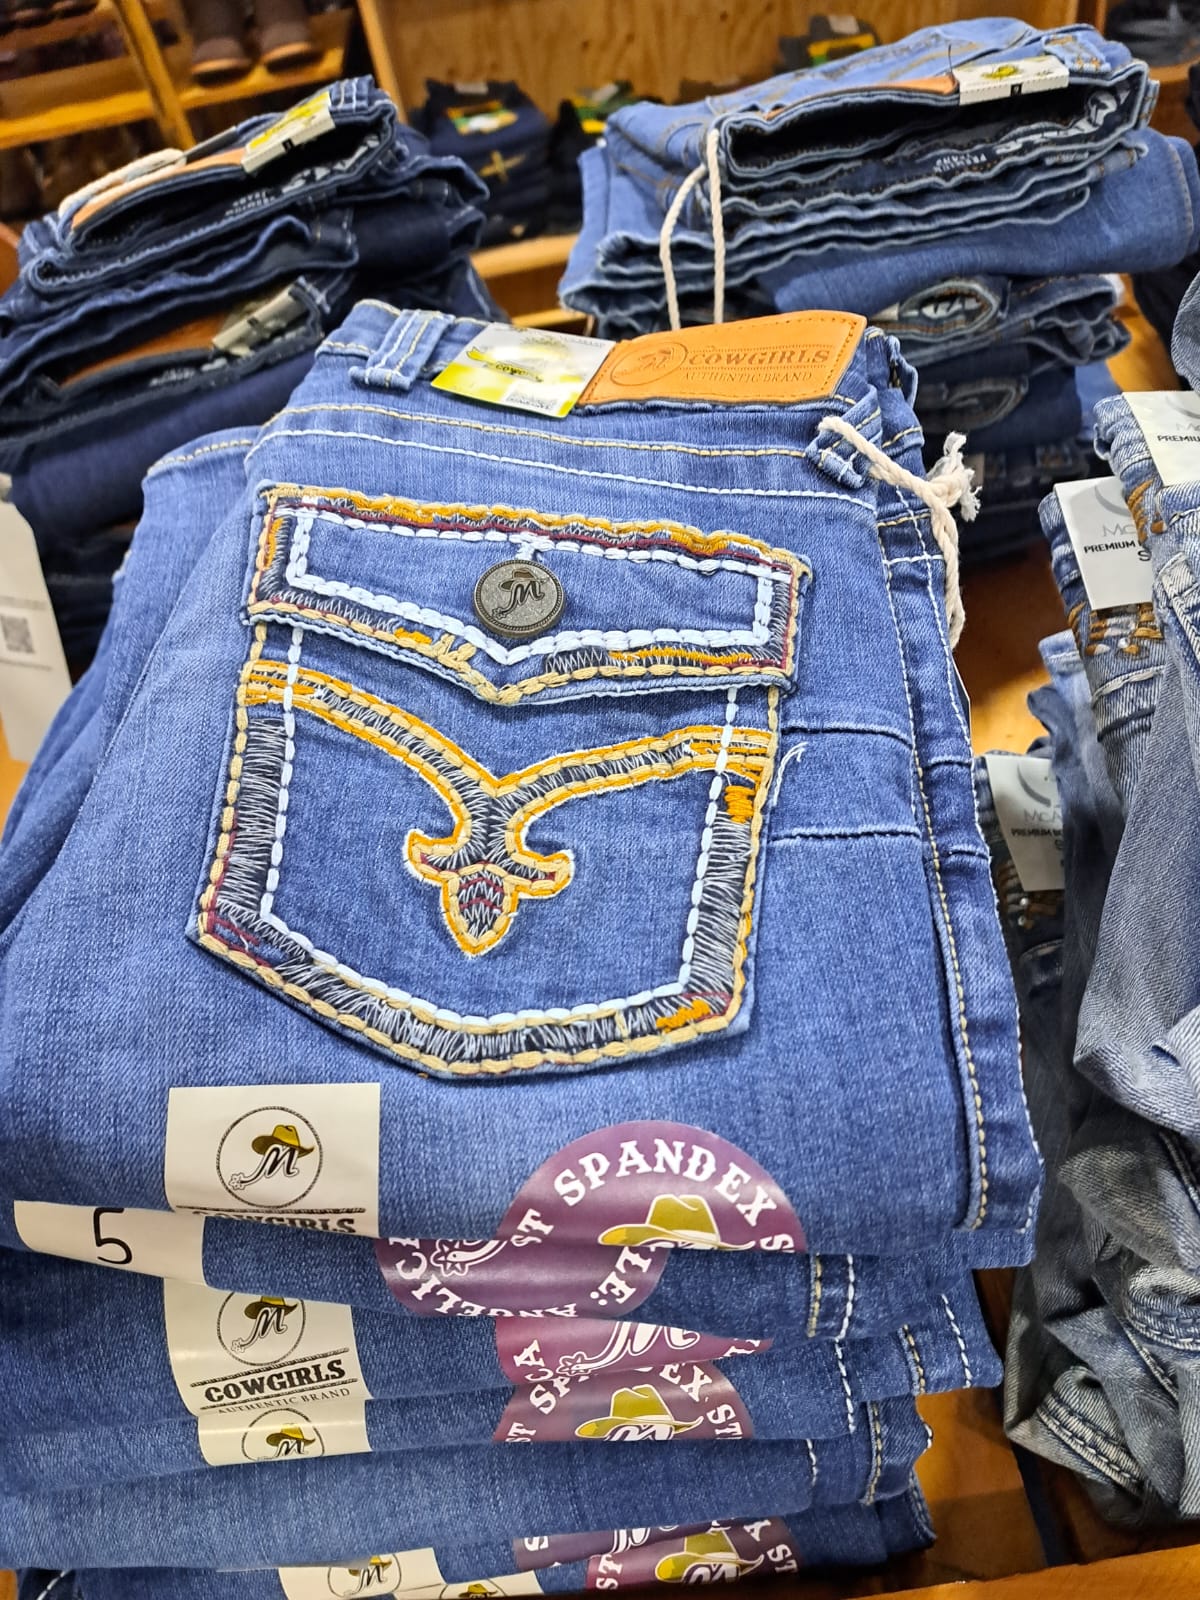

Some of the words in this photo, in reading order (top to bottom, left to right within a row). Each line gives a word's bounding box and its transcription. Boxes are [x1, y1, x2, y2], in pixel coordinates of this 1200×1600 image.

[688, 350, 831, 367] COWGIRLS
[684, 372, 759, 383] AUTHENTIC
[763, 371, 813, 383] BRAND
[1083, 540, 1136, 554] PREMIUM
[553, 1138, 778, 1227] SPANDEX
[93, 1206, 132, 1265] 5
[204, 1358, 346, 1403] COWGIRLS
[529, 1362, 713, 1415] SPEX
[218, 1396, 298, 1414] AUTHENTIC
[301, 1387, 351, 1403] BRAND
